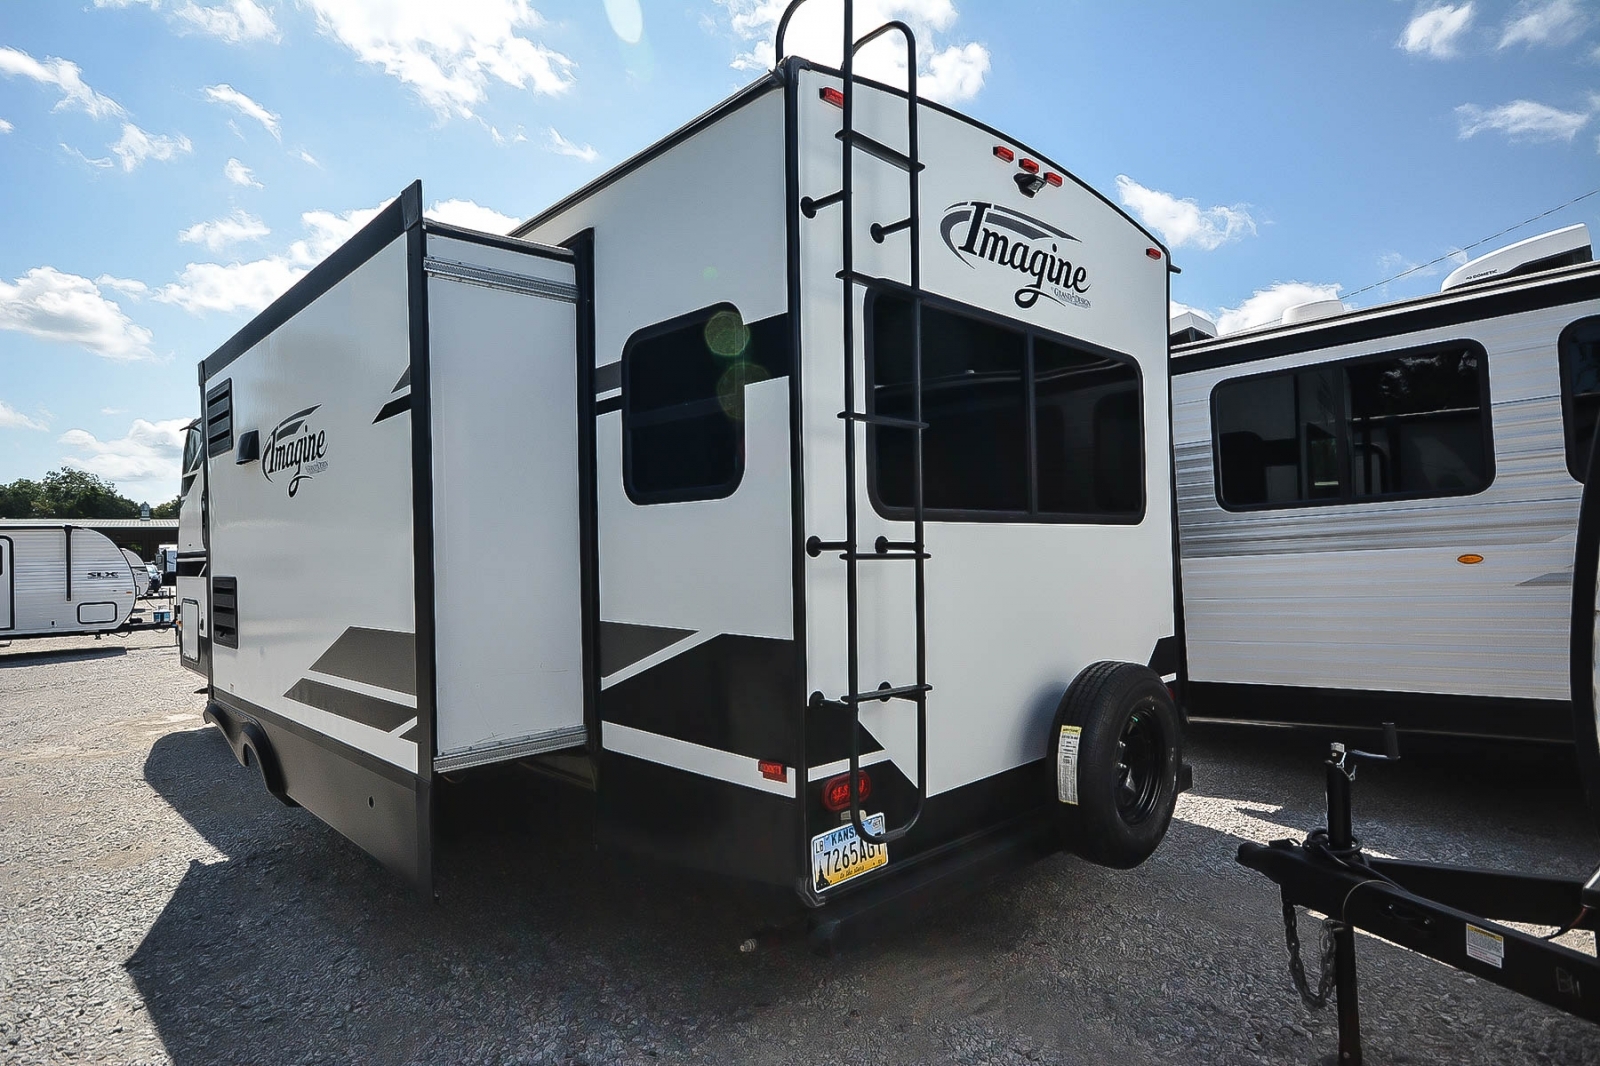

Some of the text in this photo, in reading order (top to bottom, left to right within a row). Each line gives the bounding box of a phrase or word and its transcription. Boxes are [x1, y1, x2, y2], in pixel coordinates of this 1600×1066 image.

[958, 201, 1091, 308] Imagine
[267, 424, 328, 498] Imagine
[831, 826, 858, 846] KANS
